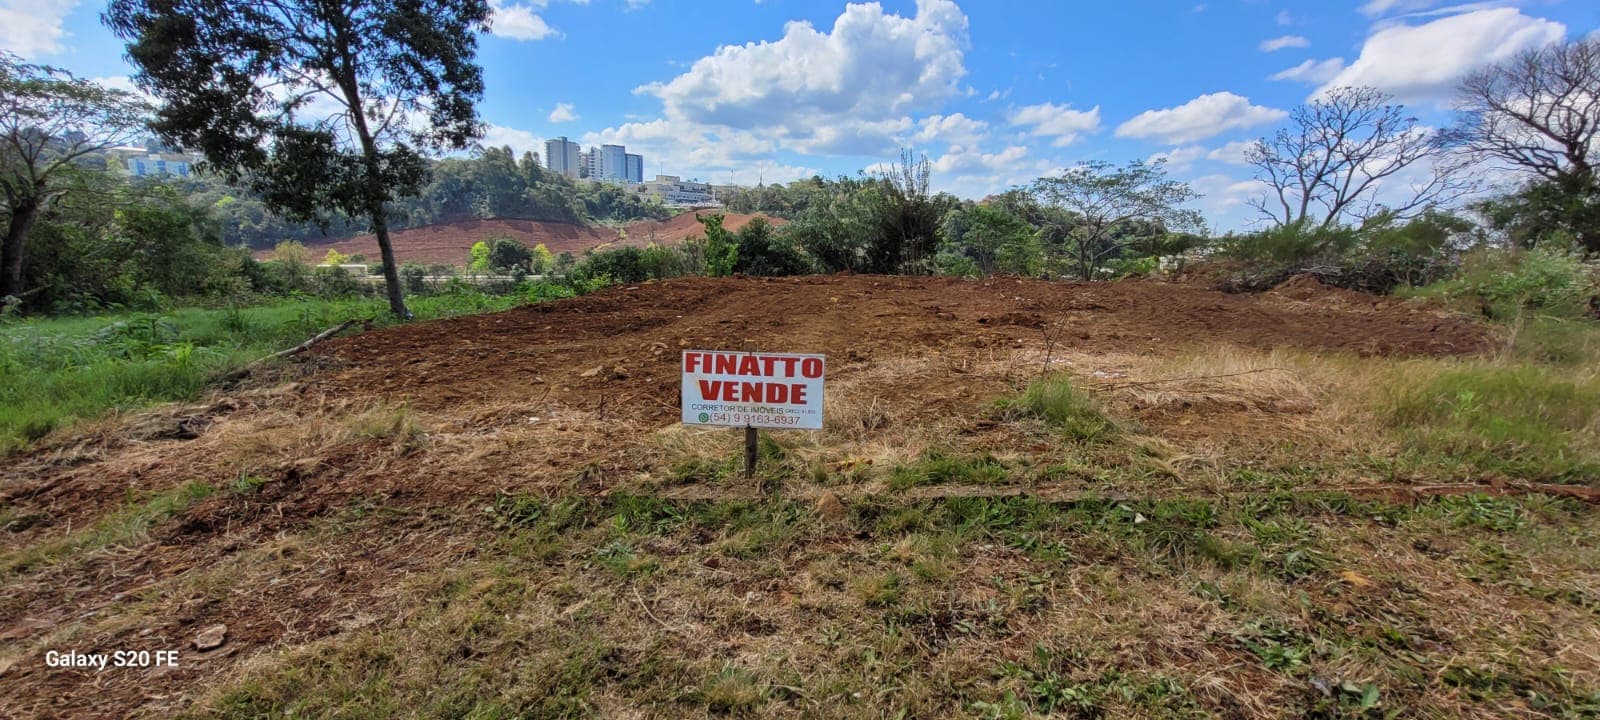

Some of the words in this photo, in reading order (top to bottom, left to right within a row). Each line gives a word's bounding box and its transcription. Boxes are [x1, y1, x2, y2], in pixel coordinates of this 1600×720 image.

[685, 353, 823, 379] FINATTO
[698, 380, 808, 404] VENDE
[692, 404, 736, 412] CORRETOR
[710, 414, 730, 424] (54)
[734, 414, 740, 422] 9
[744, 414, 800, 424] 9163-6937
